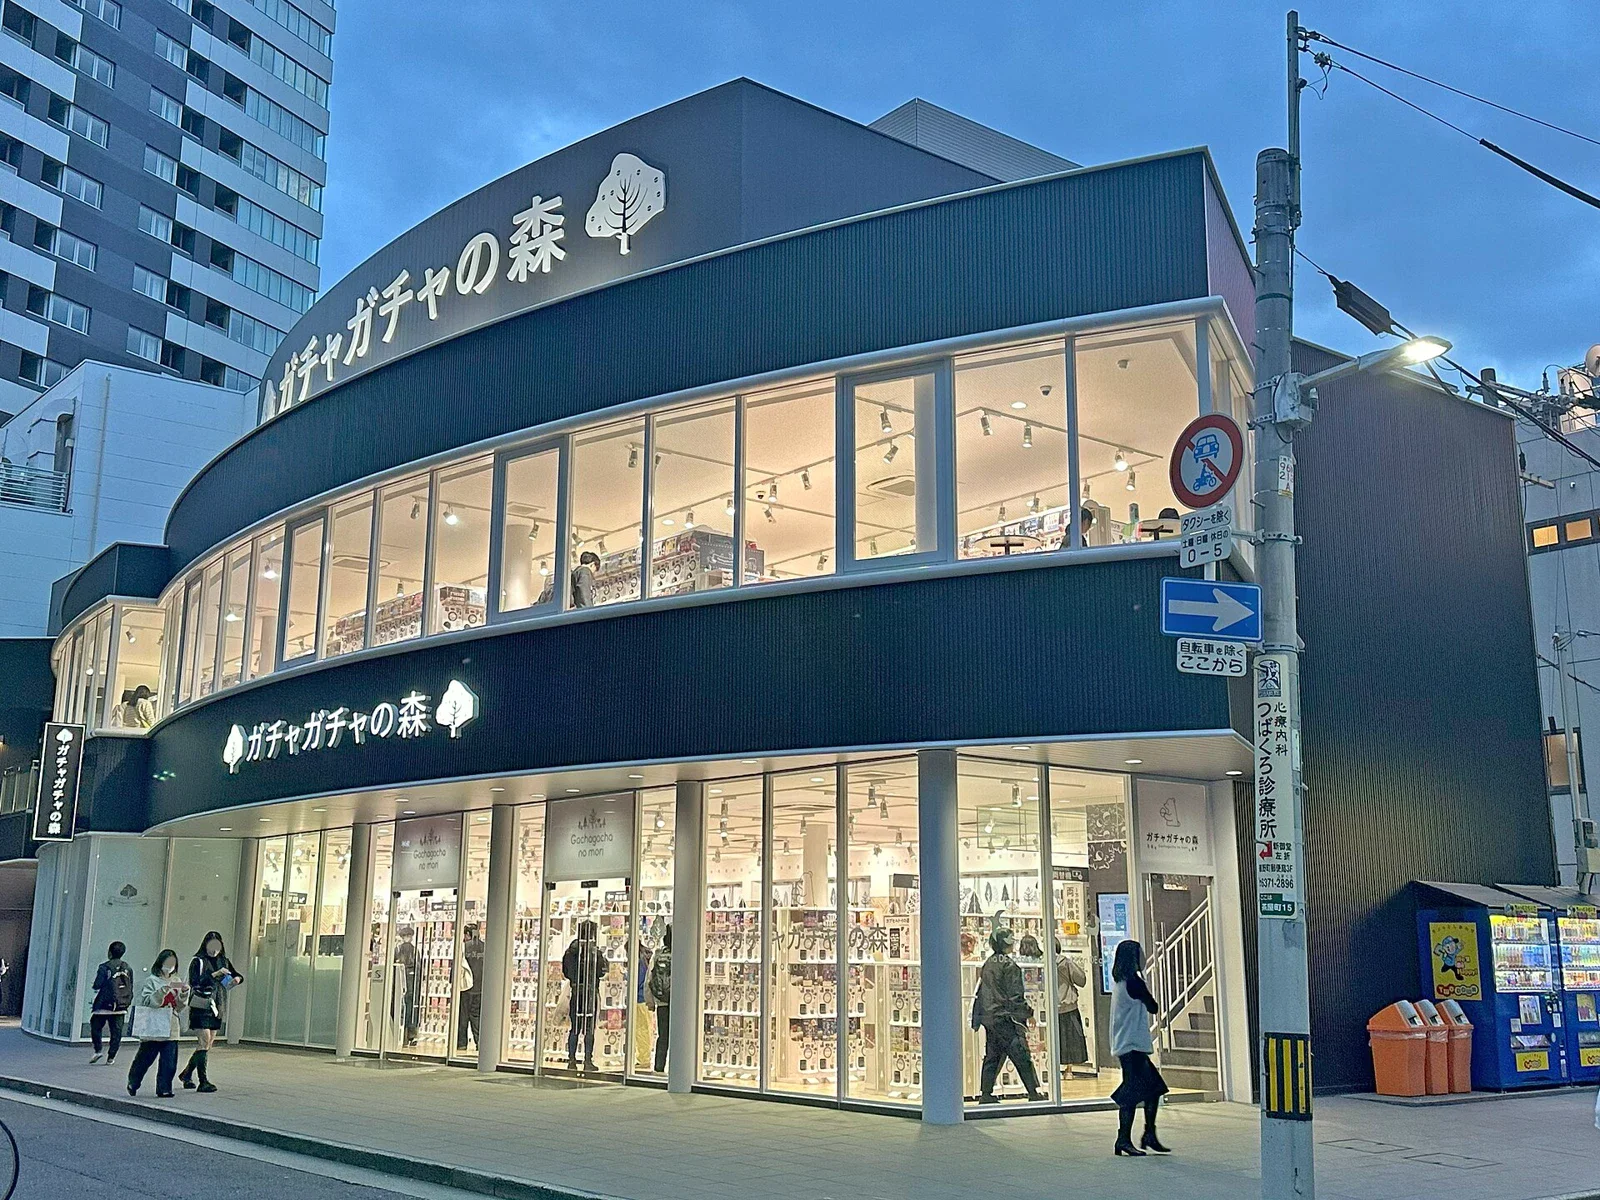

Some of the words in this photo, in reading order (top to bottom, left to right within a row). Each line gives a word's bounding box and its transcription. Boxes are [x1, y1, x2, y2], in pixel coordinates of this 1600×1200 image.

[277, 195, 566, 413] ガチャガチャの森
[1183, 509, 1229, 531] タクシーを除く
[1180, 641, 1243, 657] 自転車を除く
[1180, 655, 1243, 673] ここから
[246, 690, 430, 762] ガチャガチャの森
[1274, 702, 1288, 756] 心療内科
[48, 744, 70, 835] ガチャガチャの森
[1258, 702, 1277, 839] つばくろ診療所
[571, 832, 613, 846] Gachagacha
[1146, 832, 1199, 845] ガチャガチャの森
